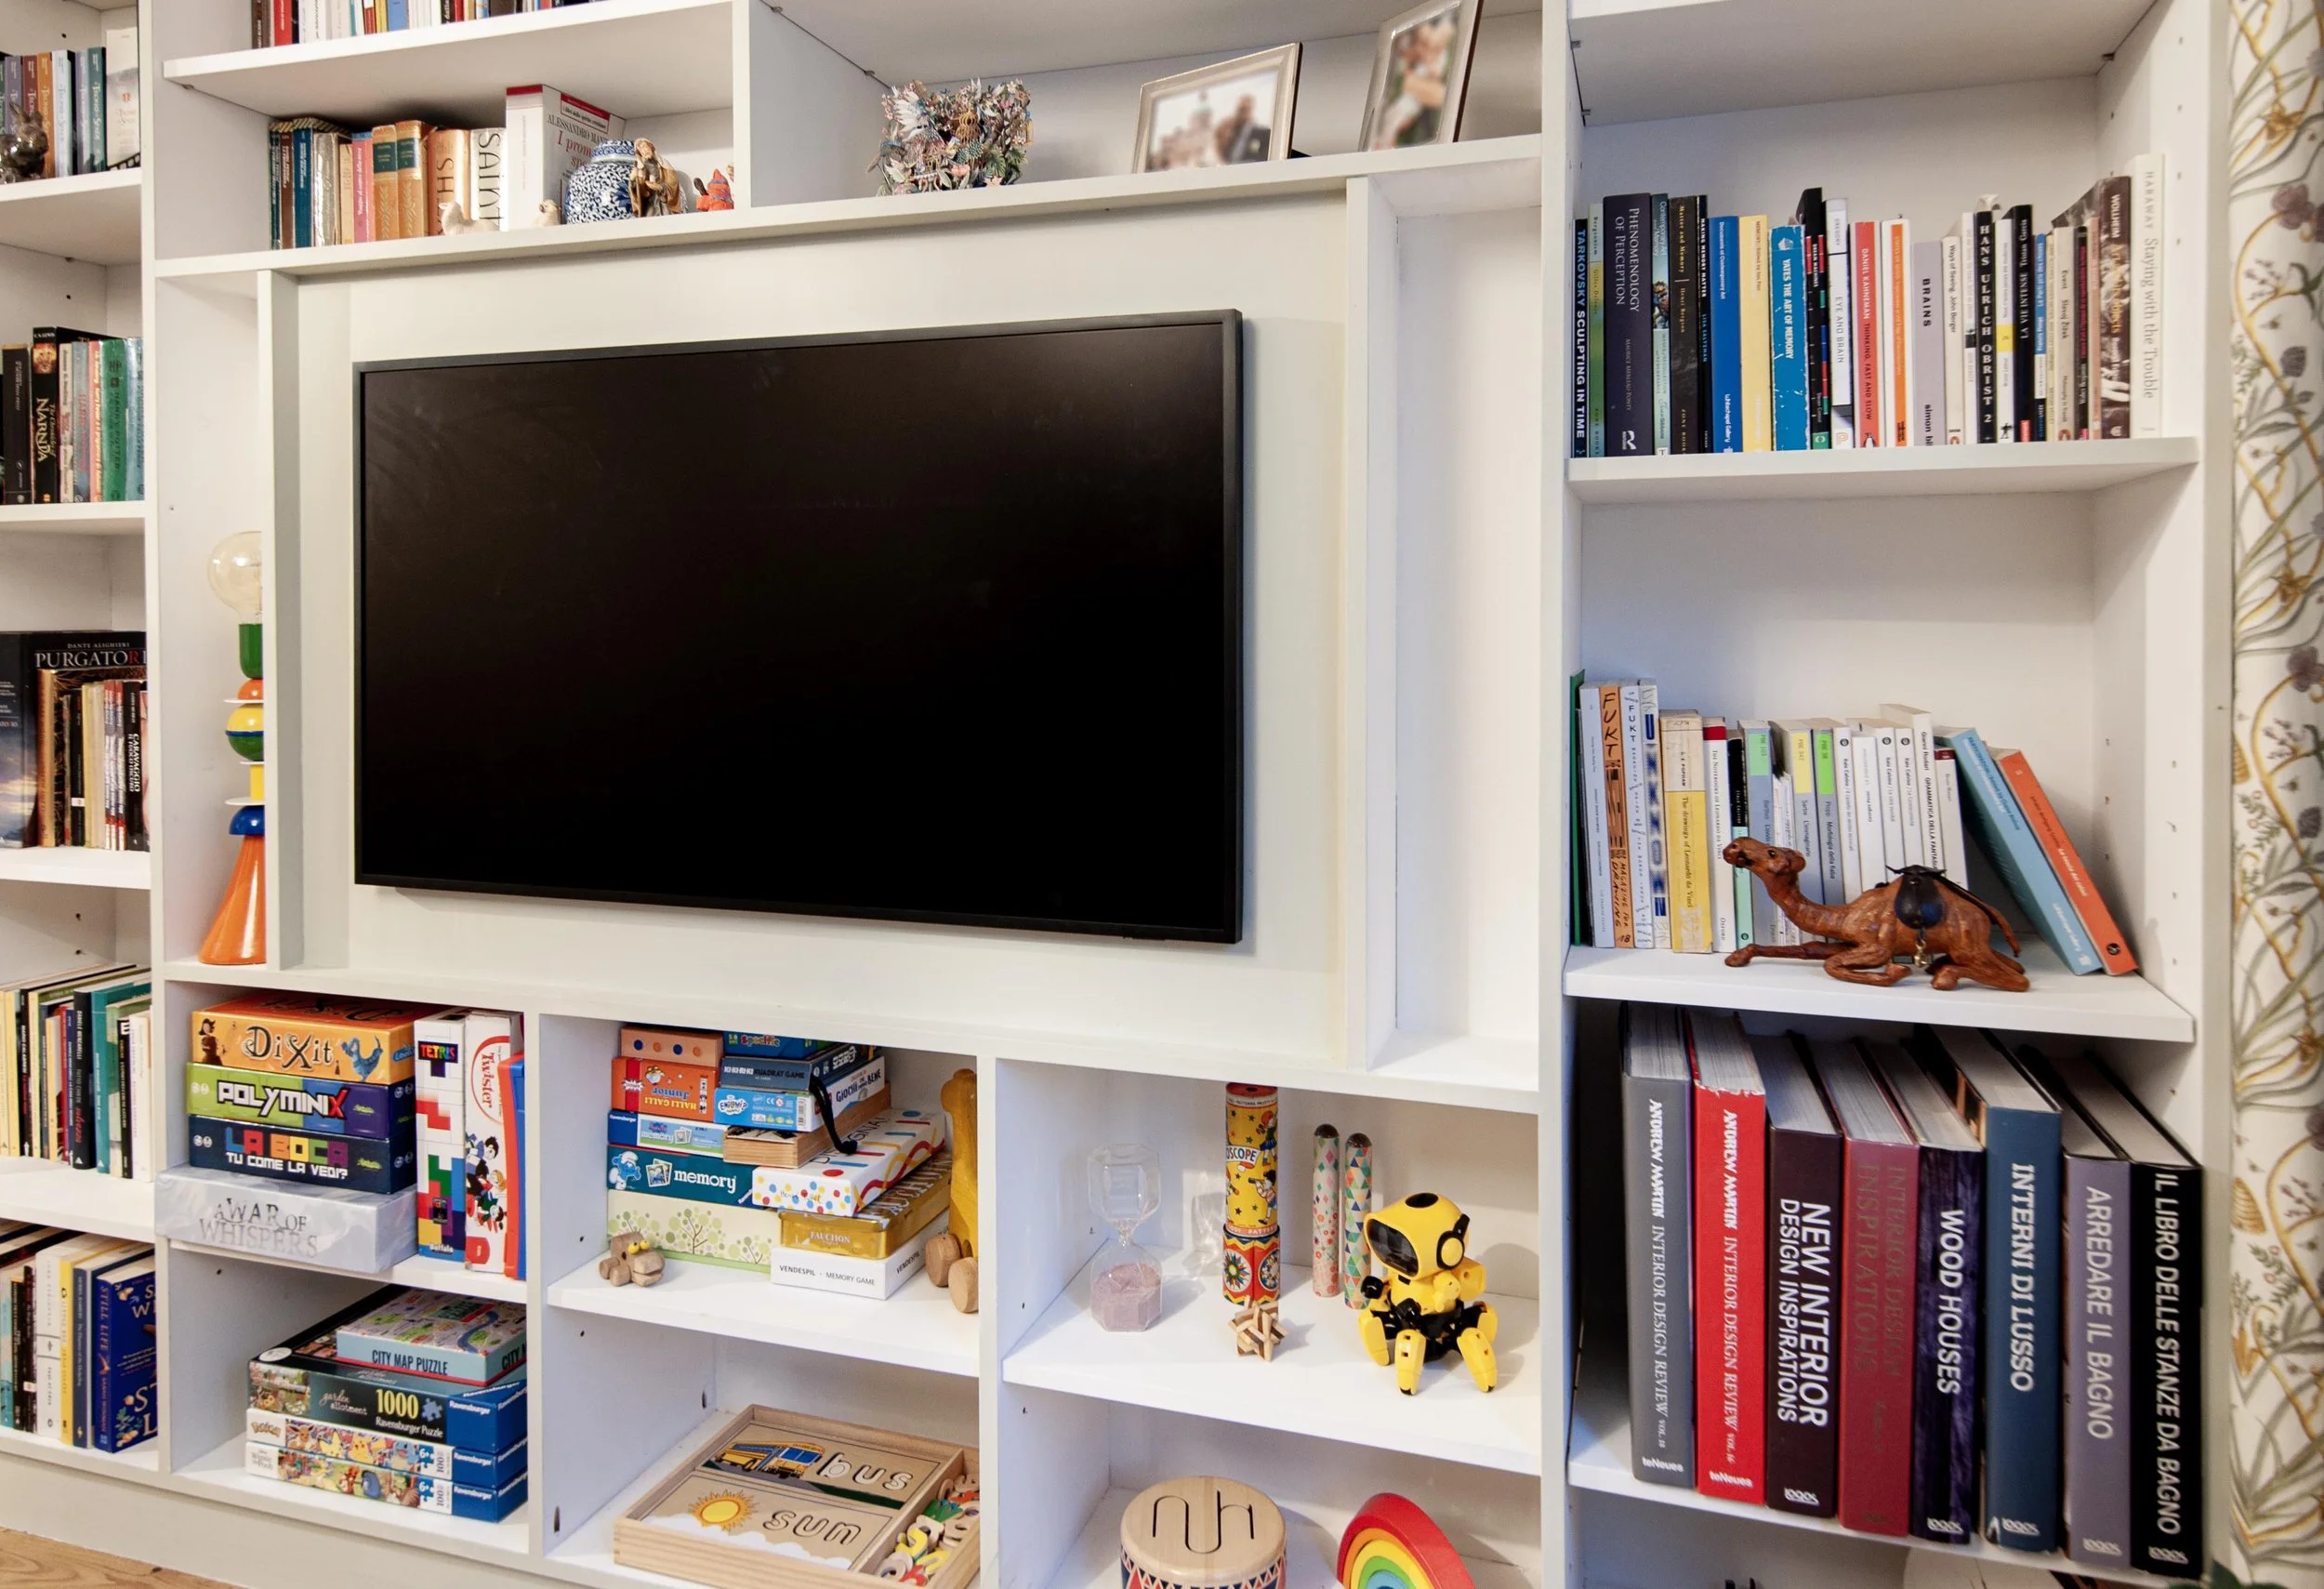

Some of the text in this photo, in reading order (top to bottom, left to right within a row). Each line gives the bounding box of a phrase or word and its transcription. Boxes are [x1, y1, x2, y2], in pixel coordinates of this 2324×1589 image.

[547, 114, 590, 139] ALESSANDRO
[557, 130, 563, 145] I
[2110, 193, 2120, 238] WOLLHEIM
[1615, 217, 1626, 305] OF PERCEPTION
[1628, 207, 1640, 312] PHENOMENOLOGY
[1861, 248, 1869, 275] DANIEL
[1835, 297, 1843, 313] EYE
[1862, 276, 1870, 320] KAHNEMAN
[1948, 245, 1958, 333] Ways of John Berger
[2020, 272, 2028, 307] INTENSE
[2060, 271, 2069, 320] Event Slavoj
[2141, 171, 2159, 399] HARAWAY Staying with the Trouble
[1782, 258, 1793, 359] YATES THE ART OF MEMORY
[1980, 225, 1994, 405] HANS ULRICH OBRIST
[2020, 310, 2028, 324] VIE
[1576, 230, 1586, 438] TARKOVSKY SCULPTING IN TIME
[1836, 337, 1844, 364] BRAIN
[2020, 327, 2028, 338] LA
[1921, 278, 1933, 432] BRAINS simon
[35, 397, 49, 462] NARNIA
[1602, 692, 1618, 759] FUKT
[1712, 762, 1722, 833] NOTEBOOKS LEONARDO
[1924, 777, 1934, 819] GRAMMATICA
[1682, 811, 1690, 840] drawings
[1826, 821, 1834, 850] Morfologia
[1618, 861, 1629, 909] MAGAZINE
[1684, 850, 1692, 879] Leonardo
[1685, 881, 1692, 889] da
[1611, 861, 1622, 927] DRAWING
[1685, 891, 1694, 908] Vinci
[244, 1026, 334, 1069] DiXit
[419, 1043, 456, 1060] TETRIS
[218, 1080, 350, 1119] POLYMINIX
[482, 1053, 495, 1106] Twister
[652, 1087, 689, 1100] Junior
[644, 1096, 697, 1110] HALLI GALLI
[224, 1126, 264, 1156] LA
[270, 1132, 349, 1169] BOCA
[226, 1151, 349, 1179] TU COME LA VEDI?
[674, 1170, 737, 1194] memory
[227, 1197, 307, 1232] WAR OF
[199, 1218, 319, 1258] WHISPERS
[810, 1230, 851, 1244] FAUCHON
[1649, 1098, 1670, 1418] ANDREW MARTIN INTERIOR DESIGN REVIEW
[779, 1265, 875, 1286] VENDESPIL MEMORY GAME
[895, 1250, 920, 1275] VENDESPIL
[1723, 1109, 1739, 1432] ANDREW MARTIN INTERIOR DESIGN REVIEW
[1854, 1164, 1878, 1375] INSPIRATIONS
[1882, 1164, 1906, 1377] INTERIOR DESIGN
[2010, 1162, 2035, 1392] INTERNI DI LUSSO
[99, 1286, 110, 1351] STILL LIFE
[1777, 1198, 1801, 1422] DESIGN INSPIRATIONS
[1799, 1202, 1831, 1426] NEW INTERIOR
[1936, 1209, 1965, 1395] WOOD HOUSES
[2085, 1185, 2114, 1438] ARREDARE IL BAGNO
[372, 1349, 392, 1365] CITY
[394, 1354, 414, 1369] MAP
[416, 1357, 448, 1376] PUZZLE
[2155, 1173, 2181, 1534] IL LIBRO DELLE STANZE DA BAGNO
[375, 1388, 419, 1420] 1000
[449, 1399, 491, 1415] Ravensburger
[375, 1416, 443, 1438] Ravensburger Puzzle
[816, 1452, 915, 1491] bus
[762, 1509, 862, 1545] sun
